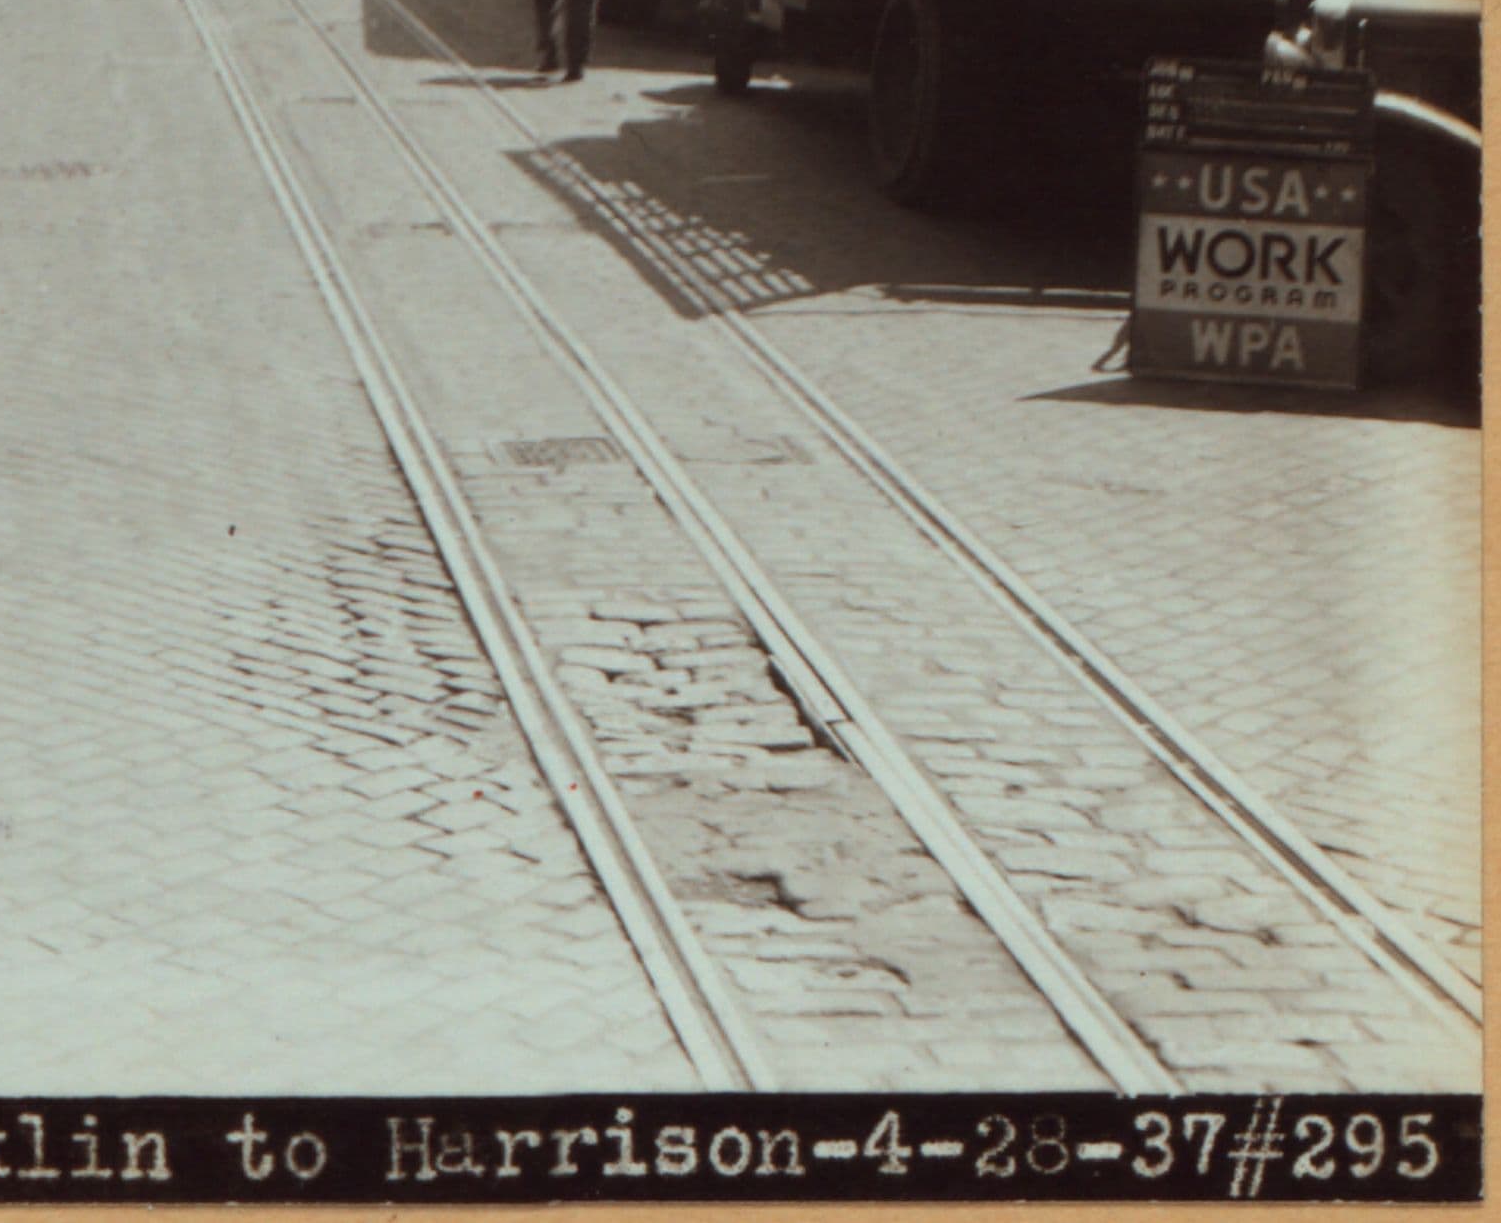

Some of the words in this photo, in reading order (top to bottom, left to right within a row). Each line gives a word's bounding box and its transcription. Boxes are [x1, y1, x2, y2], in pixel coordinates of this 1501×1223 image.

[1201, 164, 1309, 215] USA
[1157, 225, 1345, 286] WORK
[1160, 281, 1337, 309] PROGRAM
[1191, 318, 1304, 370] WPA
